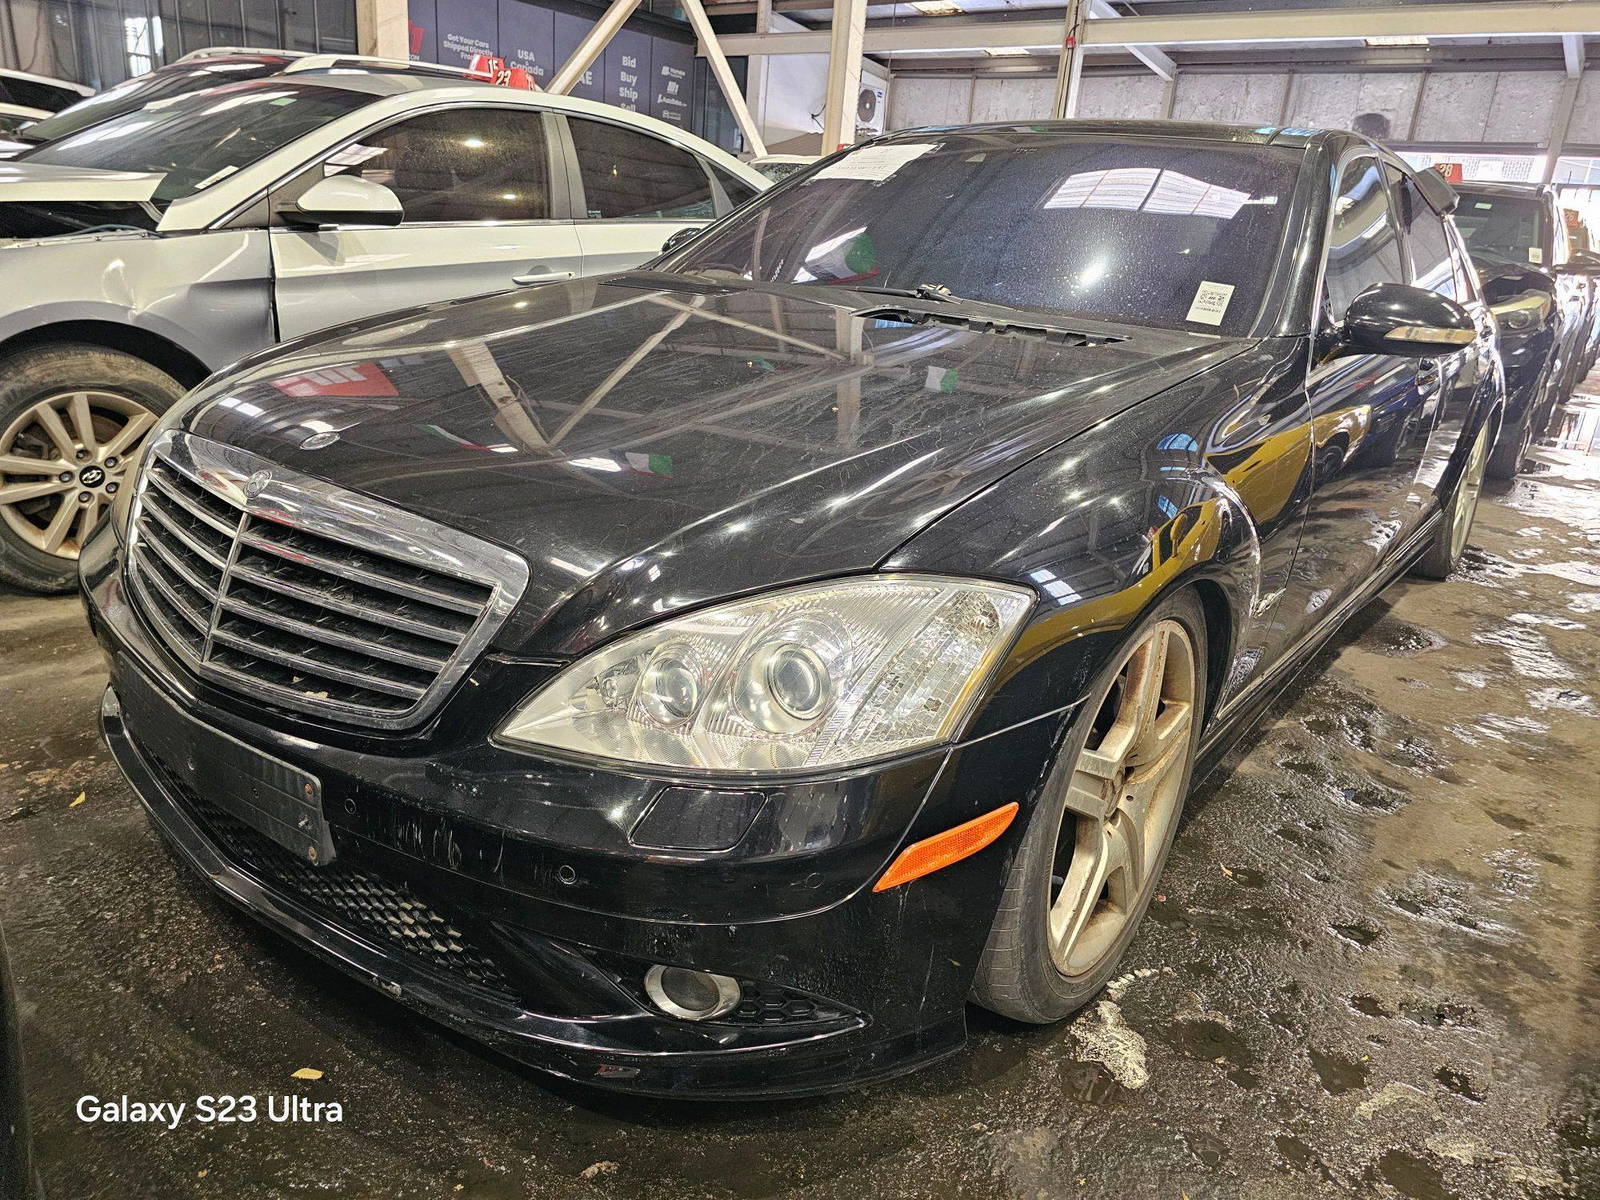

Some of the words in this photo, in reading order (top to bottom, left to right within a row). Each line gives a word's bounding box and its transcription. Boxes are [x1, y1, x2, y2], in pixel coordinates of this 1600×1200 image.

[443, 40, 469, 52] Shipped
[447, 33, 459, 42] Get
[459, 35, 474, 45] Your
[474, 39, 490, 49] Cars
[460, 51, 475, 60] Fro
[517, 49, 535, 62] USA
[622, 55, 637, 69] Bid
[510, 61, 544, 76] Canada
[496, 69, 512, 87] 23
[620, 71, 638, 87] Buy
[619, 86, 638, 102] Ship
